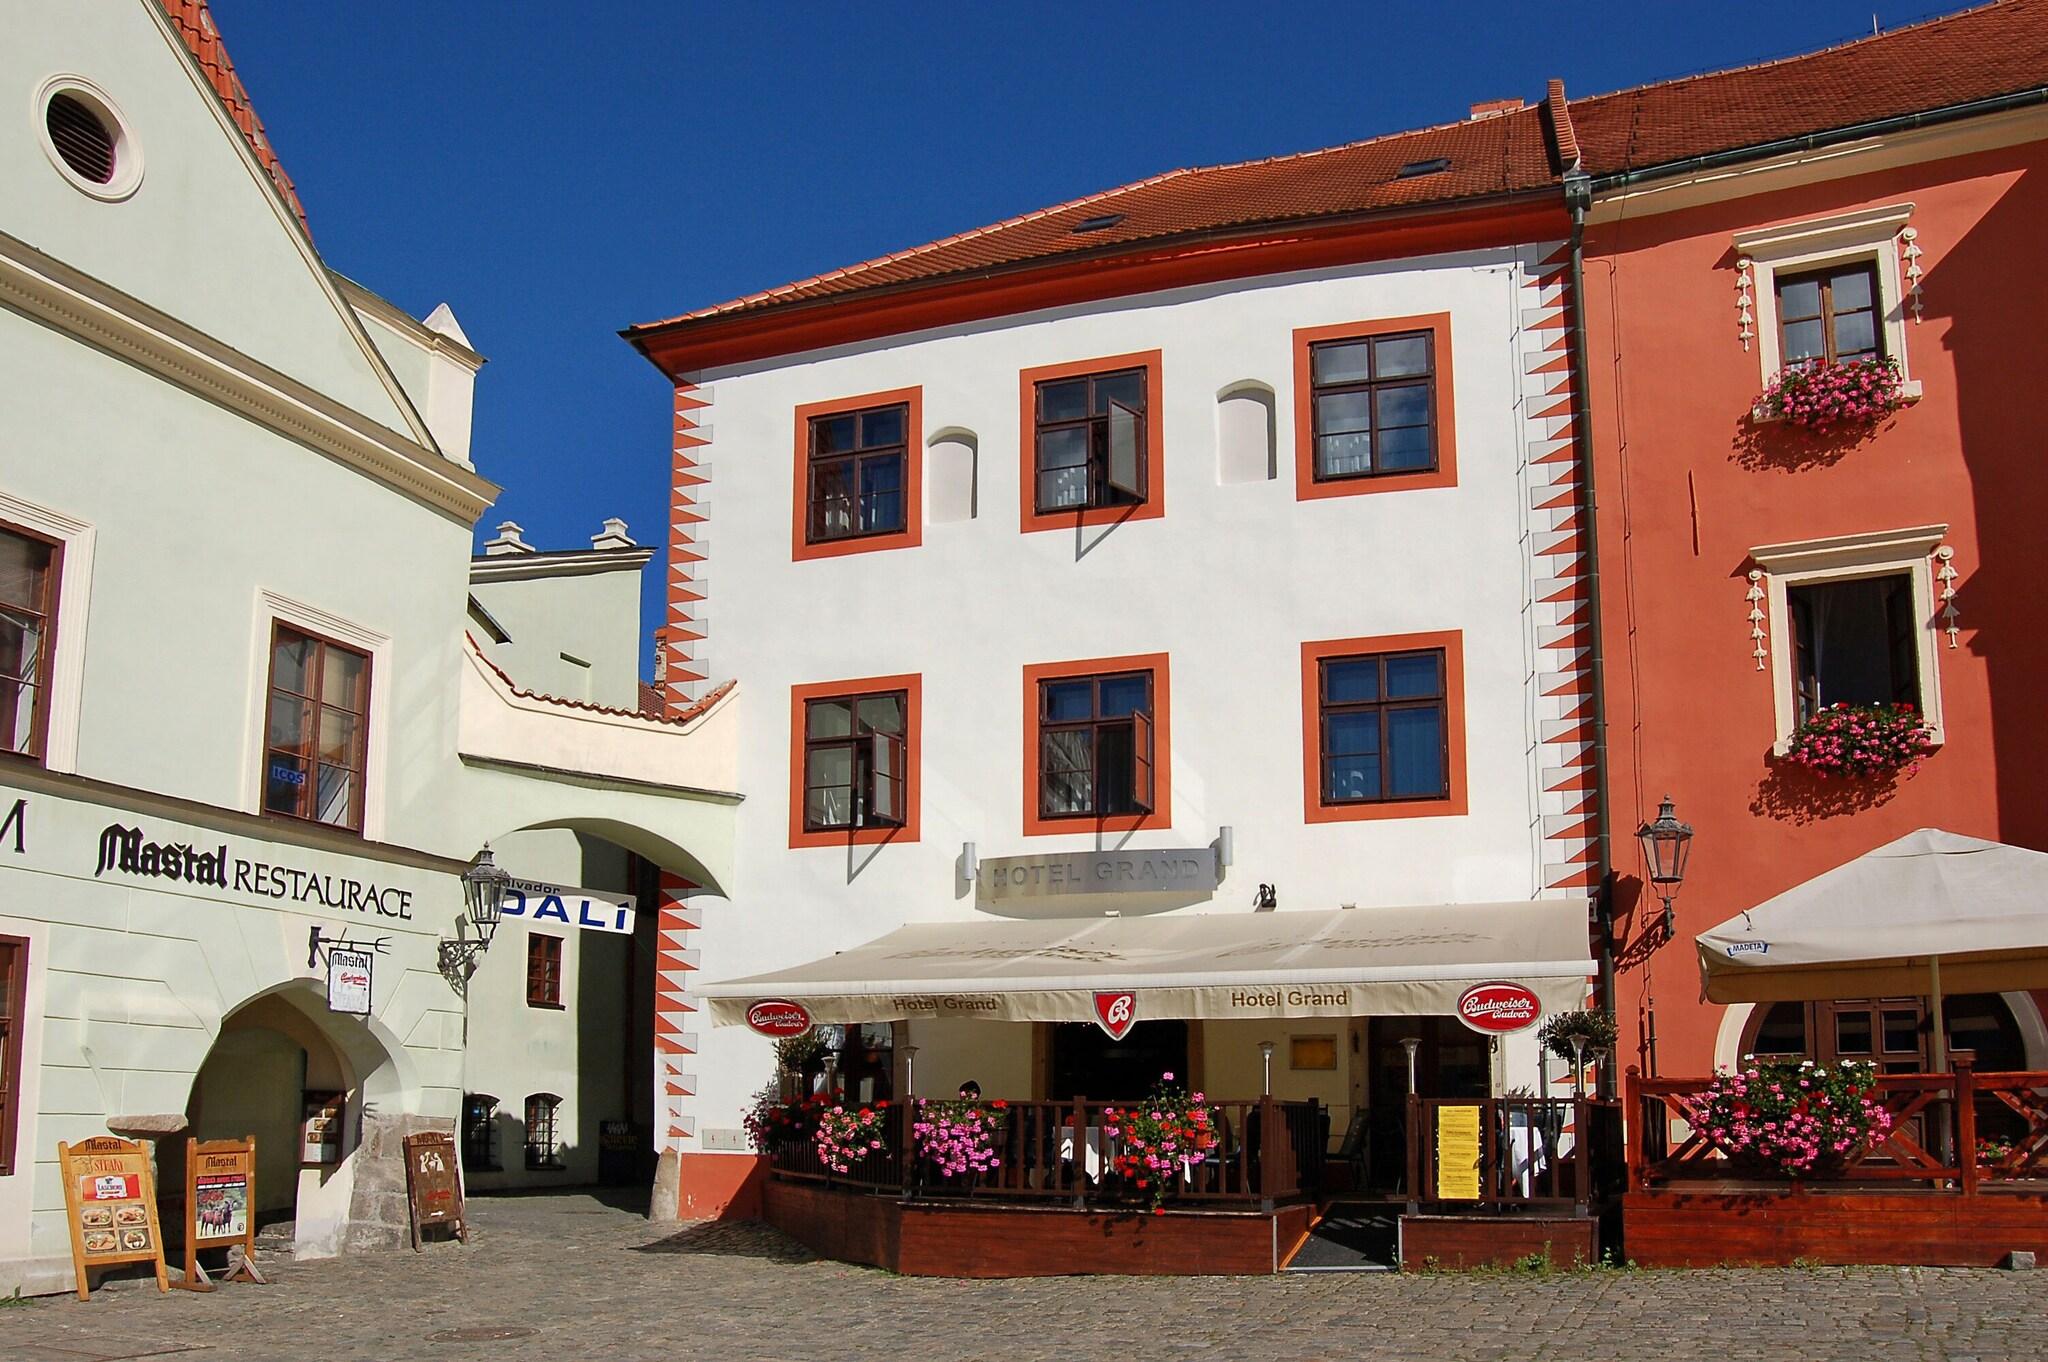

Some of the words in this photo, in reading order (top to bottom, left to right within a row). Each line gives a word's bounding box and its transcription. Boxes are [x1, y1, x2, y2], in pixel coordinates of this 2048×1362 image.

[95, 823, 228, 889] Maštal
[233, 858, 413, 920] RESTAURACE
[993, 864, 1081, 888] HOTEL
[1095, 859, 1200, 881] GRAND
[1732, 942, 1763, 952] MADETA
[893, 997, 939, 1012] Hotel
[944, 997, 997, 1011] Grand
[1231, 991, 1281, 1007] Hotel
[1287, 990, 1348, 1006] Grand
[1463, 996, 1533, 1015] Budweiser
[1492, 1007, 1532, 1019] Budvar
